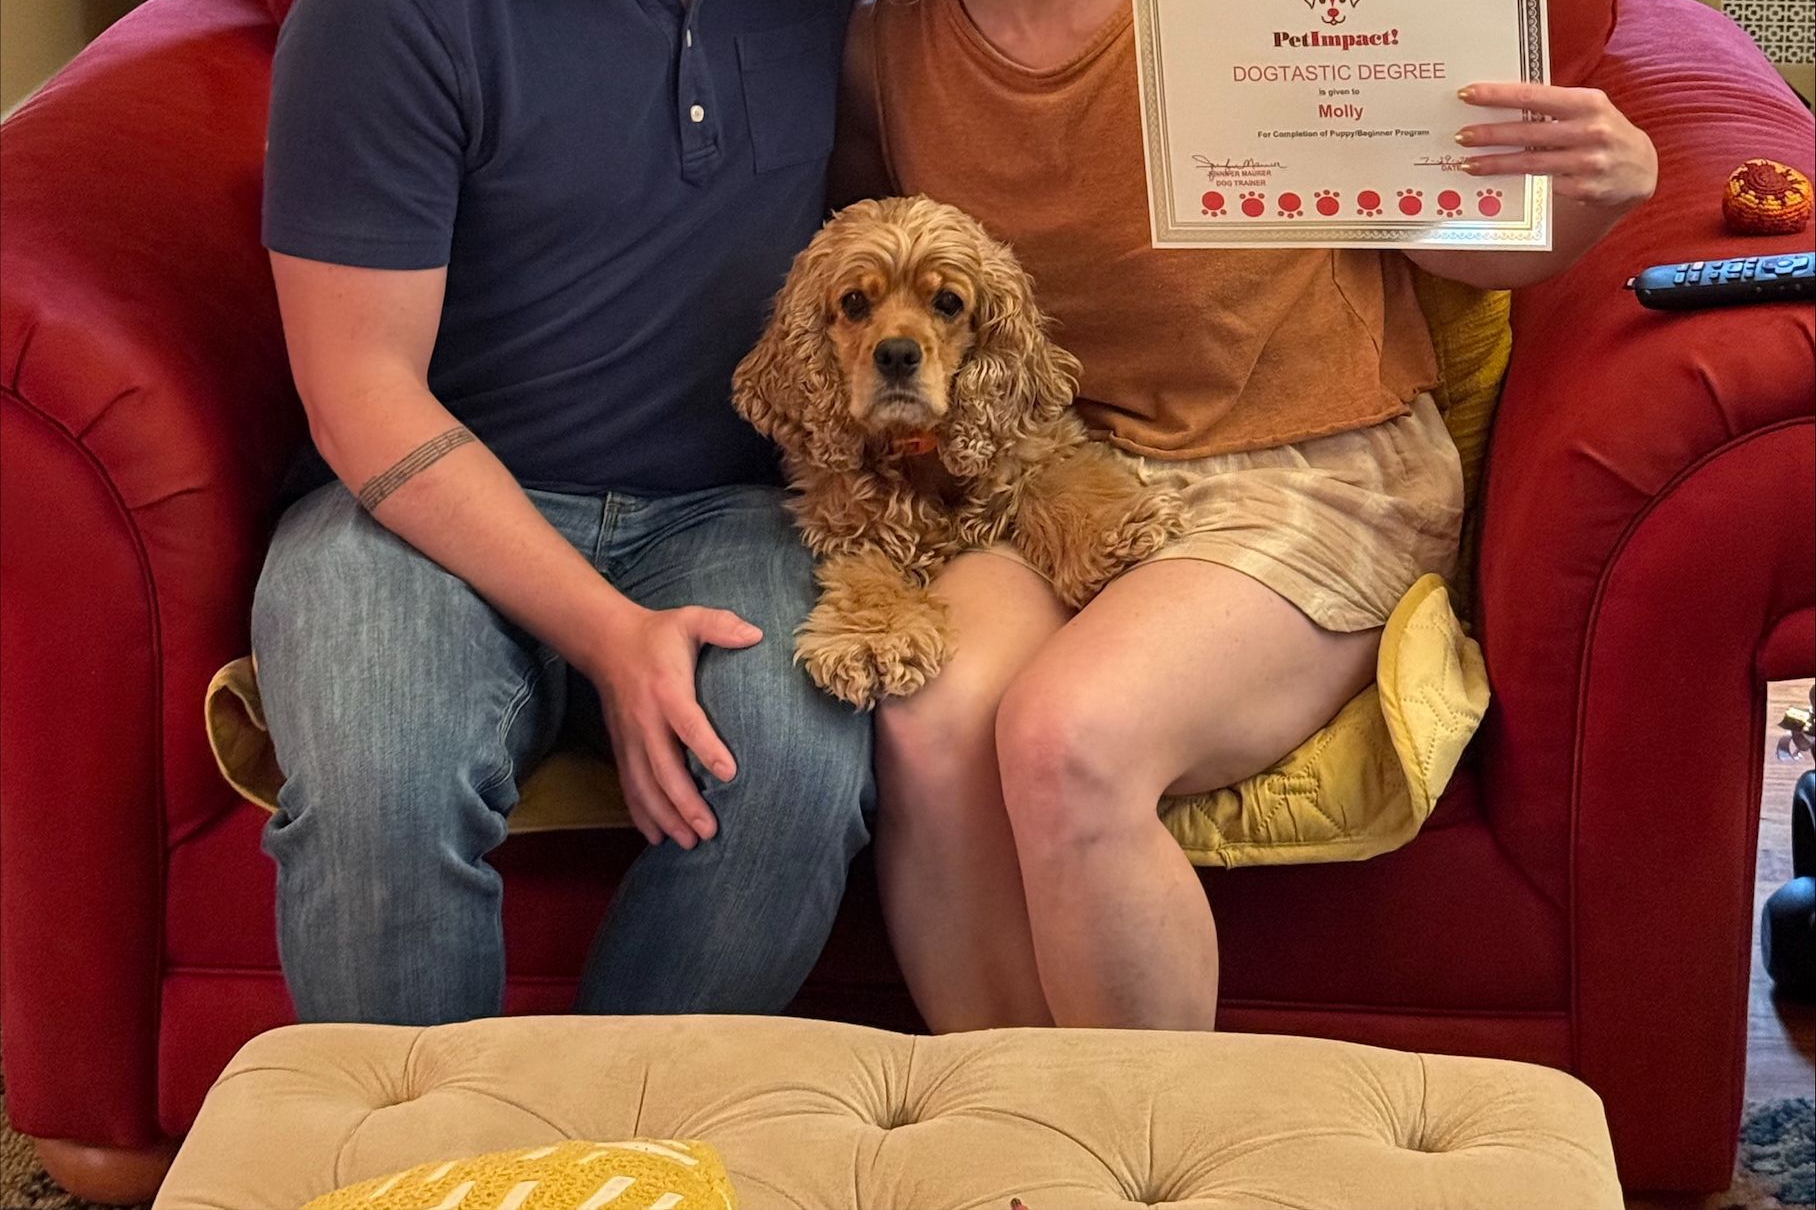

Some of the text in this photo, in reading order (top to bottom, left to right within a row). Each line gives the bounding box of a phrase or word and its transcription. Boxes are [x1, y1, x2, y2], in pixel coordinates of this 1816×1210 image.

[1273, 28, 1399, 51] PetImpact!
[1232, 62, 1446, 82] DOGTASTIC DEGREE
[1318, 88, 1360, 97] is given to
[1318, 104, 1364, 121] Molly
[1257, 128, 1430, 139] For Completion of Puppy/Beginner Program
